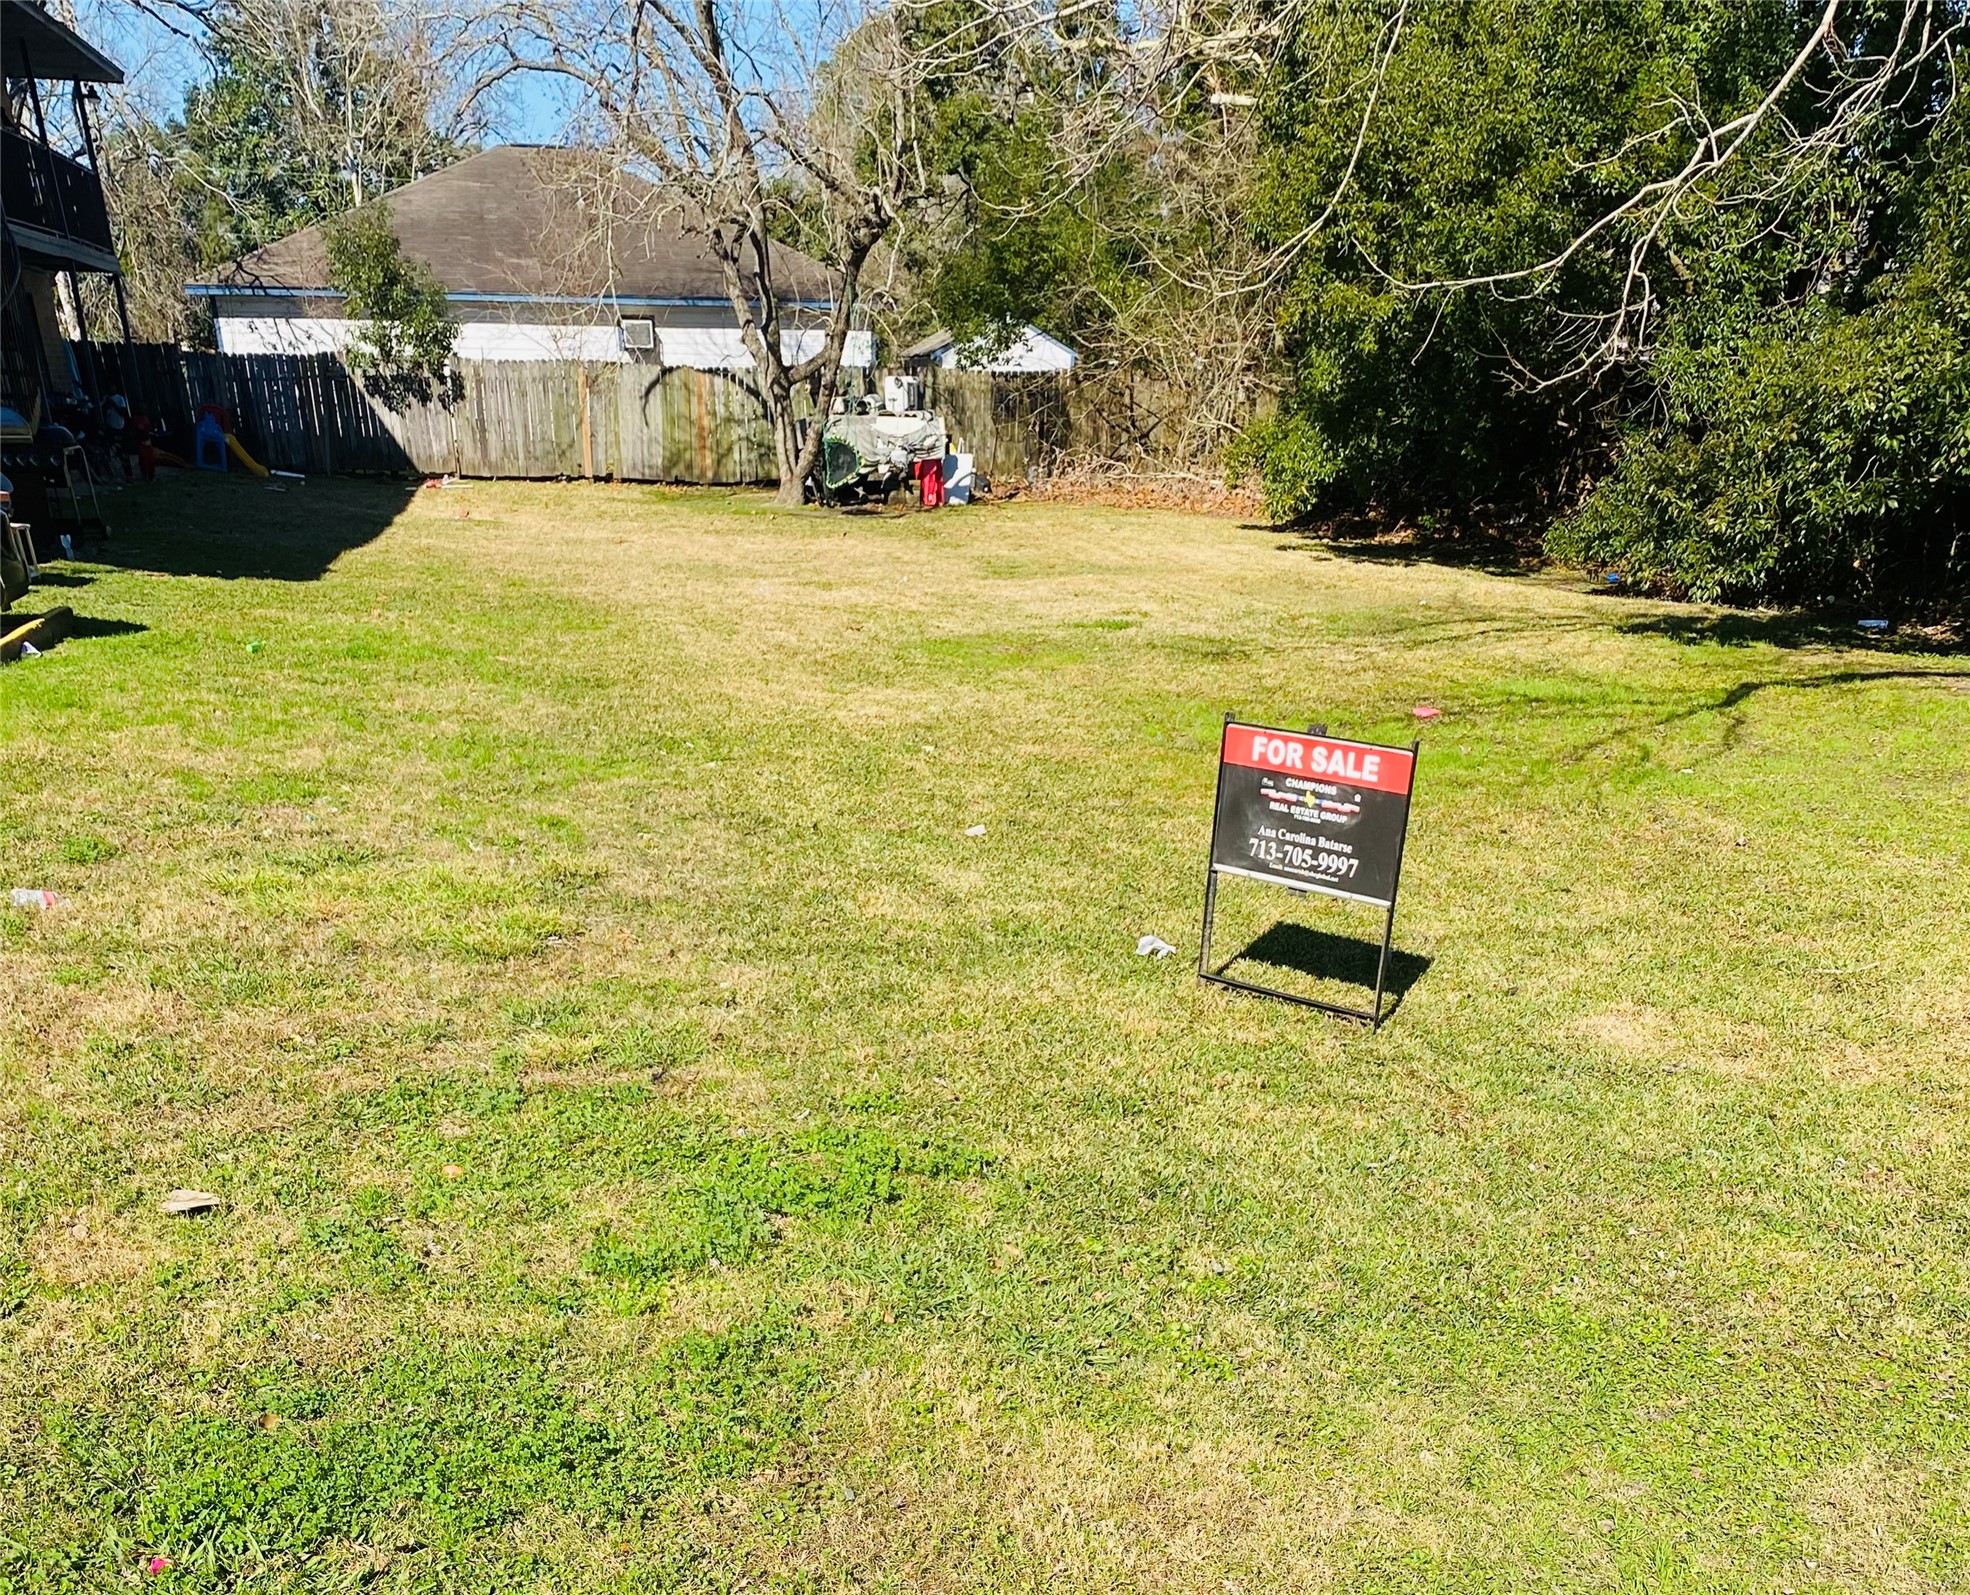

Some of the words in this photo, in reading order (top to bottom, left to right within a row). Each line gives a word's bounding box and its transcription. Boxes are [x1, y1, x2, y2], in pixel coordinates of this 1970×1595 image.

[1252, 736, 1304, 769] FOR
[1311, 746, 1381, 782] SALE
[1285, 777, 1337, 796] CHAMPIONS
[1269, 801, 1289, 813] REAL
[1290, 805, 1319, 819] ESTATE
[1320, 811, 1348, 824] GROUP
[1258, 825, 1277, 838] Ana
[1278, 828, 1317, 846] Carolina
[1317, 836, 1353, 854] Batarse
[1249, 838, 1359, 878] 713-705-9997
